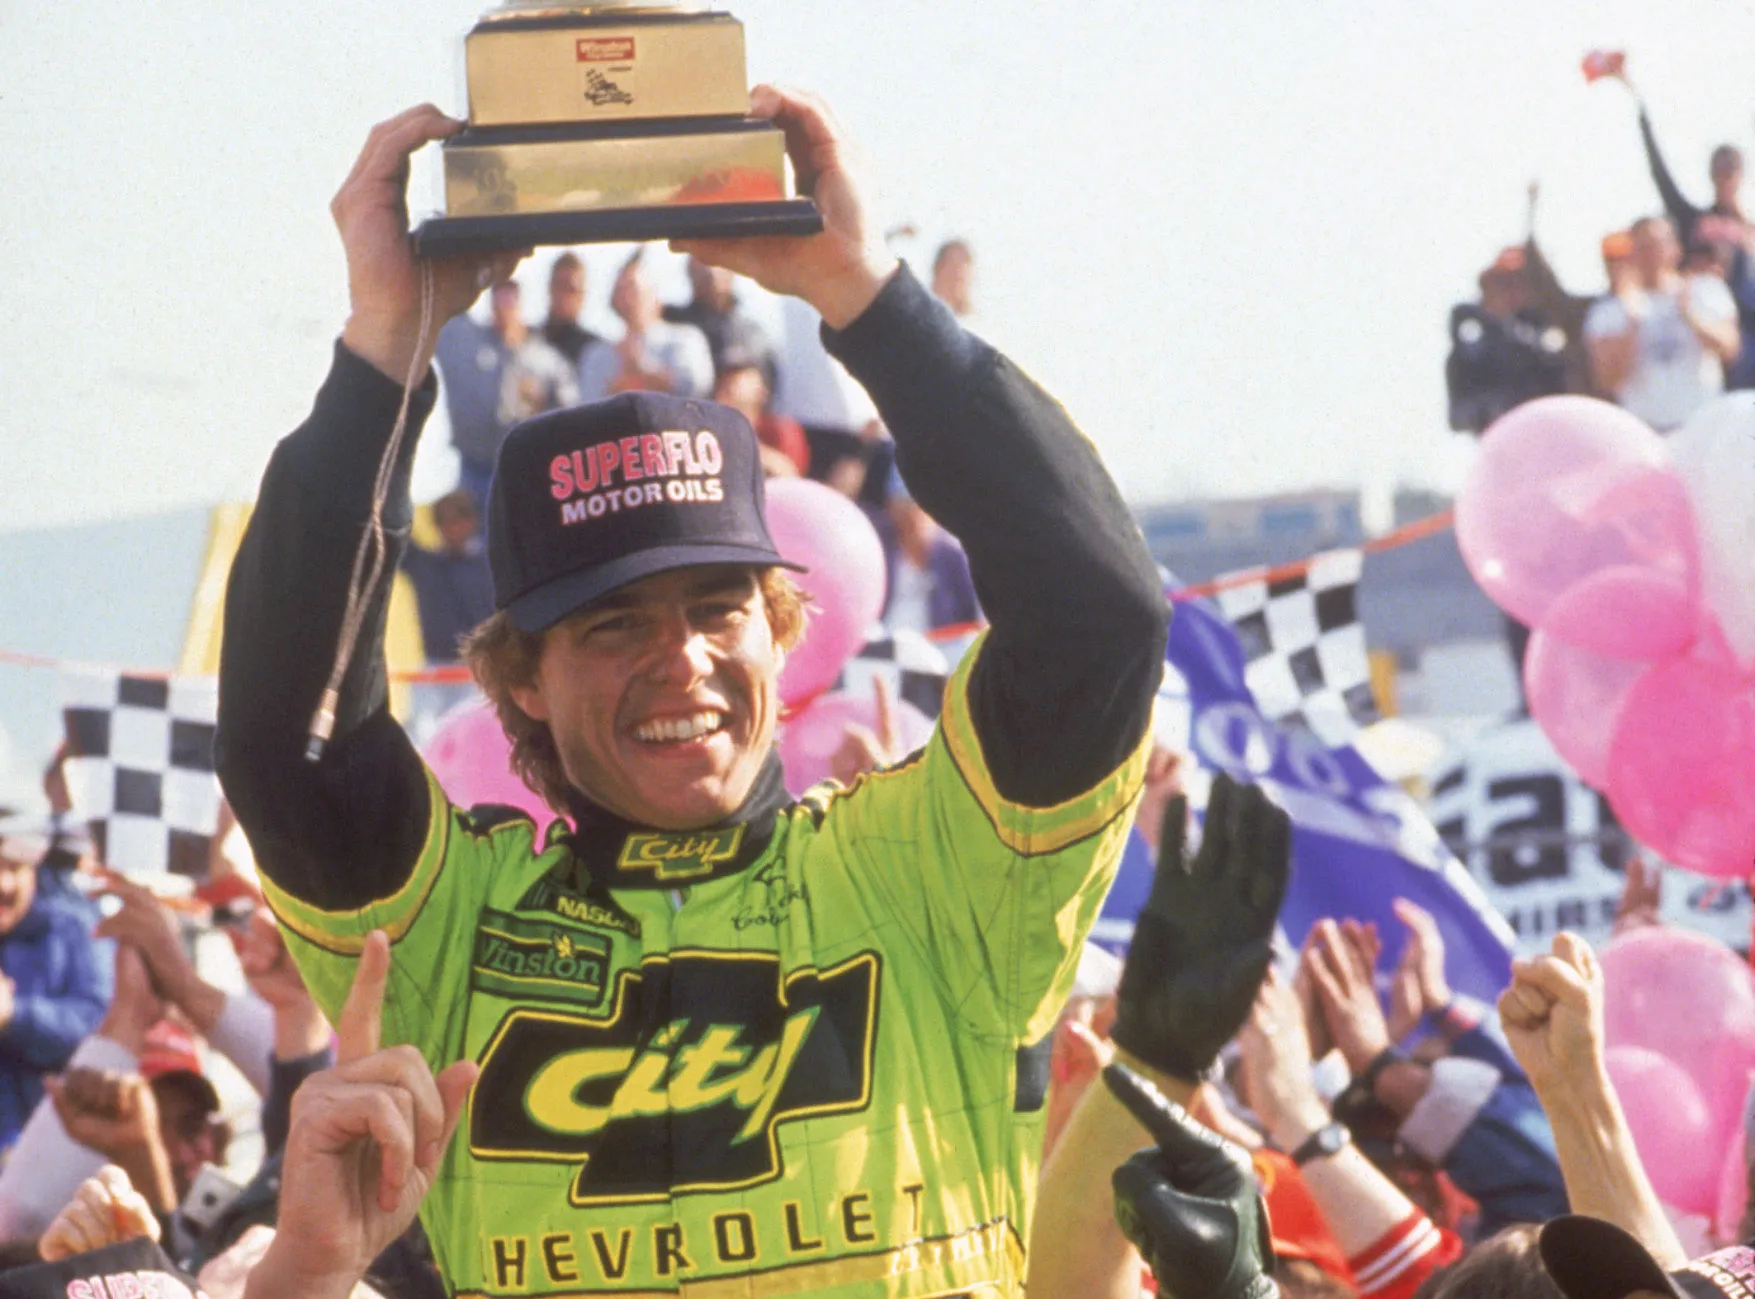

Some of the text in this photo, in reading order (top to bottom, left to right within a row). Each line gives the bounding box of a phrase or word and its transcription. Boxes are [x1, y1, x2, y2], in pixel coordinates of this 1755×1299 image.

[549, 429, 723, 499] SUPERFLO
[561, 477, 724, 526] MOTOR OILS
[482, 1184, 925, 1289] HEVROLET
